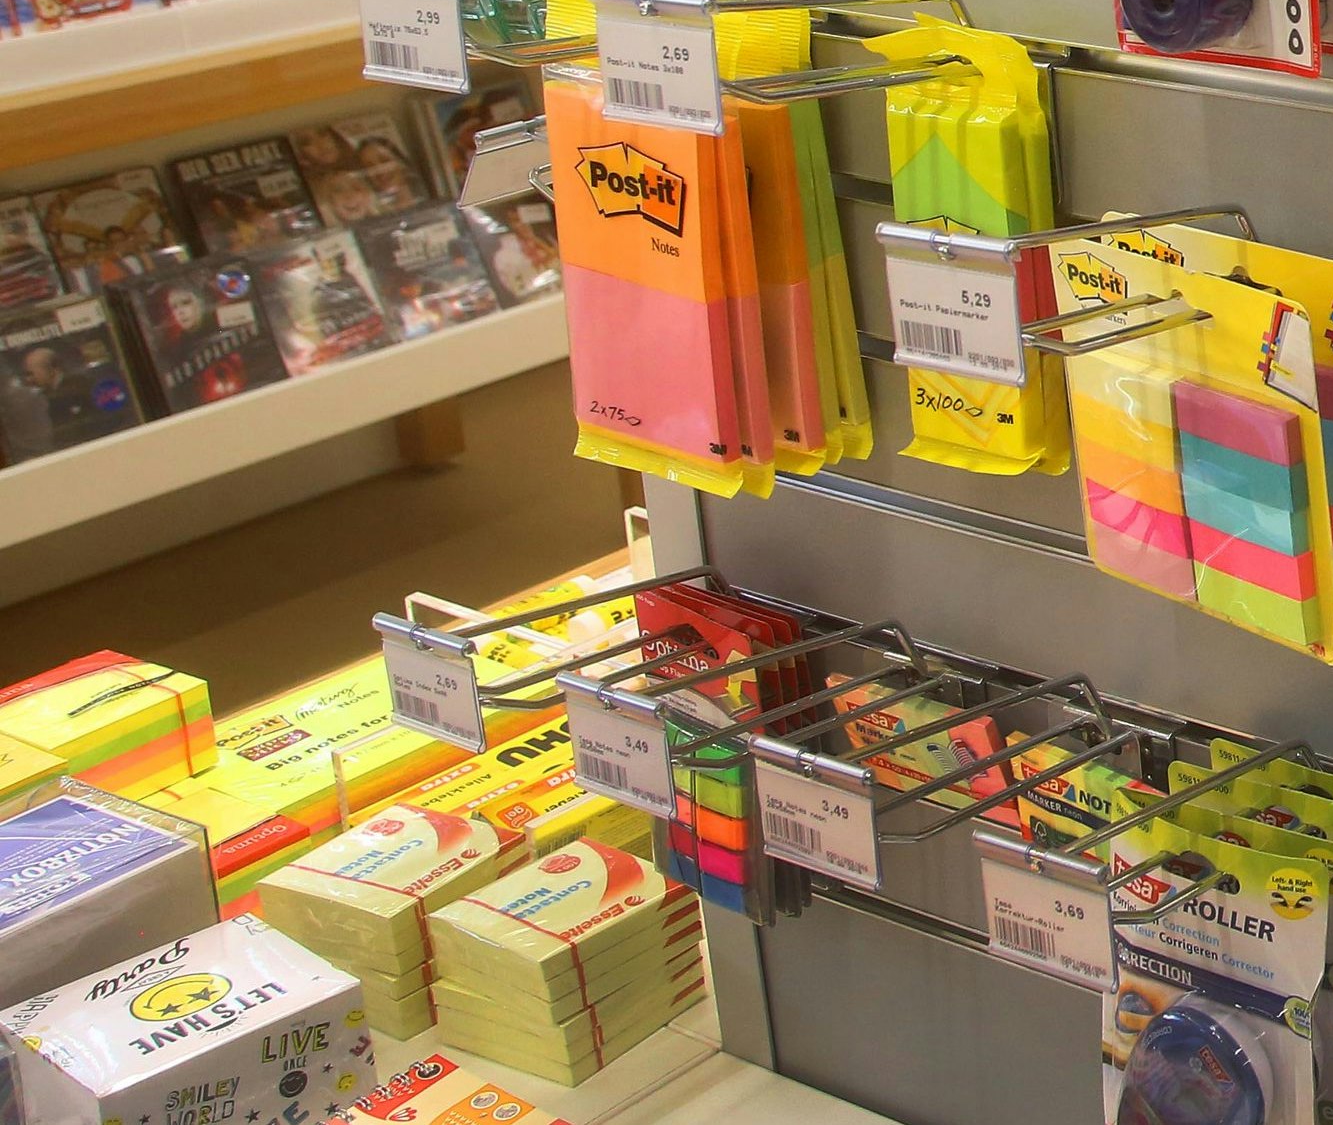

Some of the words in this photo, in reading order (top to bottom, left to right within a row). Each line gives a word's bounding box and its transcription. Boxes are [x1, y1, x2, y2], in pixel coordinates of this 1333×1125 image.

[417, 10, 440, 25] 2,99
[606, 56, 635, 69] Post-it
[638, 60, 660, 72] Notes
[662, 45, 690, 62] 2,69
[589, 159, 678, 208] Post-it
[651, 237, 680, 258] Notes
[1066, 262, 1124, 296] Post-it
[900, 298, 933, 312] Post-it
[961, 290, 991, 308] 5,29
[589, 400, 626, 421] 2x75
[915, 387, 965, 413] 3x100
[996, 412, 1014, 425] 3M
[709, 442, 728, 456] 3M
[783, 428, 800, 443] 3M
[435, 674, 459, 690] 2,69
[265, 753, 303, 771] Big
[304, 728, 360, 754] notes
[360, 714, 390, 730] for
[625, 736, 650, 754] 3,49
[419, 763, 475, 792] extra
[420, 773, 493, 808] Allesklebe
[466, 780, 521, 810] extra
[1026, 790, 1062, 813] MARKER
[822, 799, 850, 820] 3,49
[221, 823, 289, 856] Optima
[400, 857, 465, 898] Esselte
[560, 903, 625, 942] Esselte
[1054, 900, 1085, 921] 3,69
[1183, 896, 1276, 943] ROLLER
[1162, 917, 1220, 947] Correction
[1158, 931, 1219, 961] Corrigeren
[1221, 952, 1275, 981] Corrector
[213, 981, 290, 1022] LET'S
[129, 1011, 219, 1057] HAVE
[261, 1022, 331, 1064] LIVE
[165, 1075, 242, 1113] SMILEY
